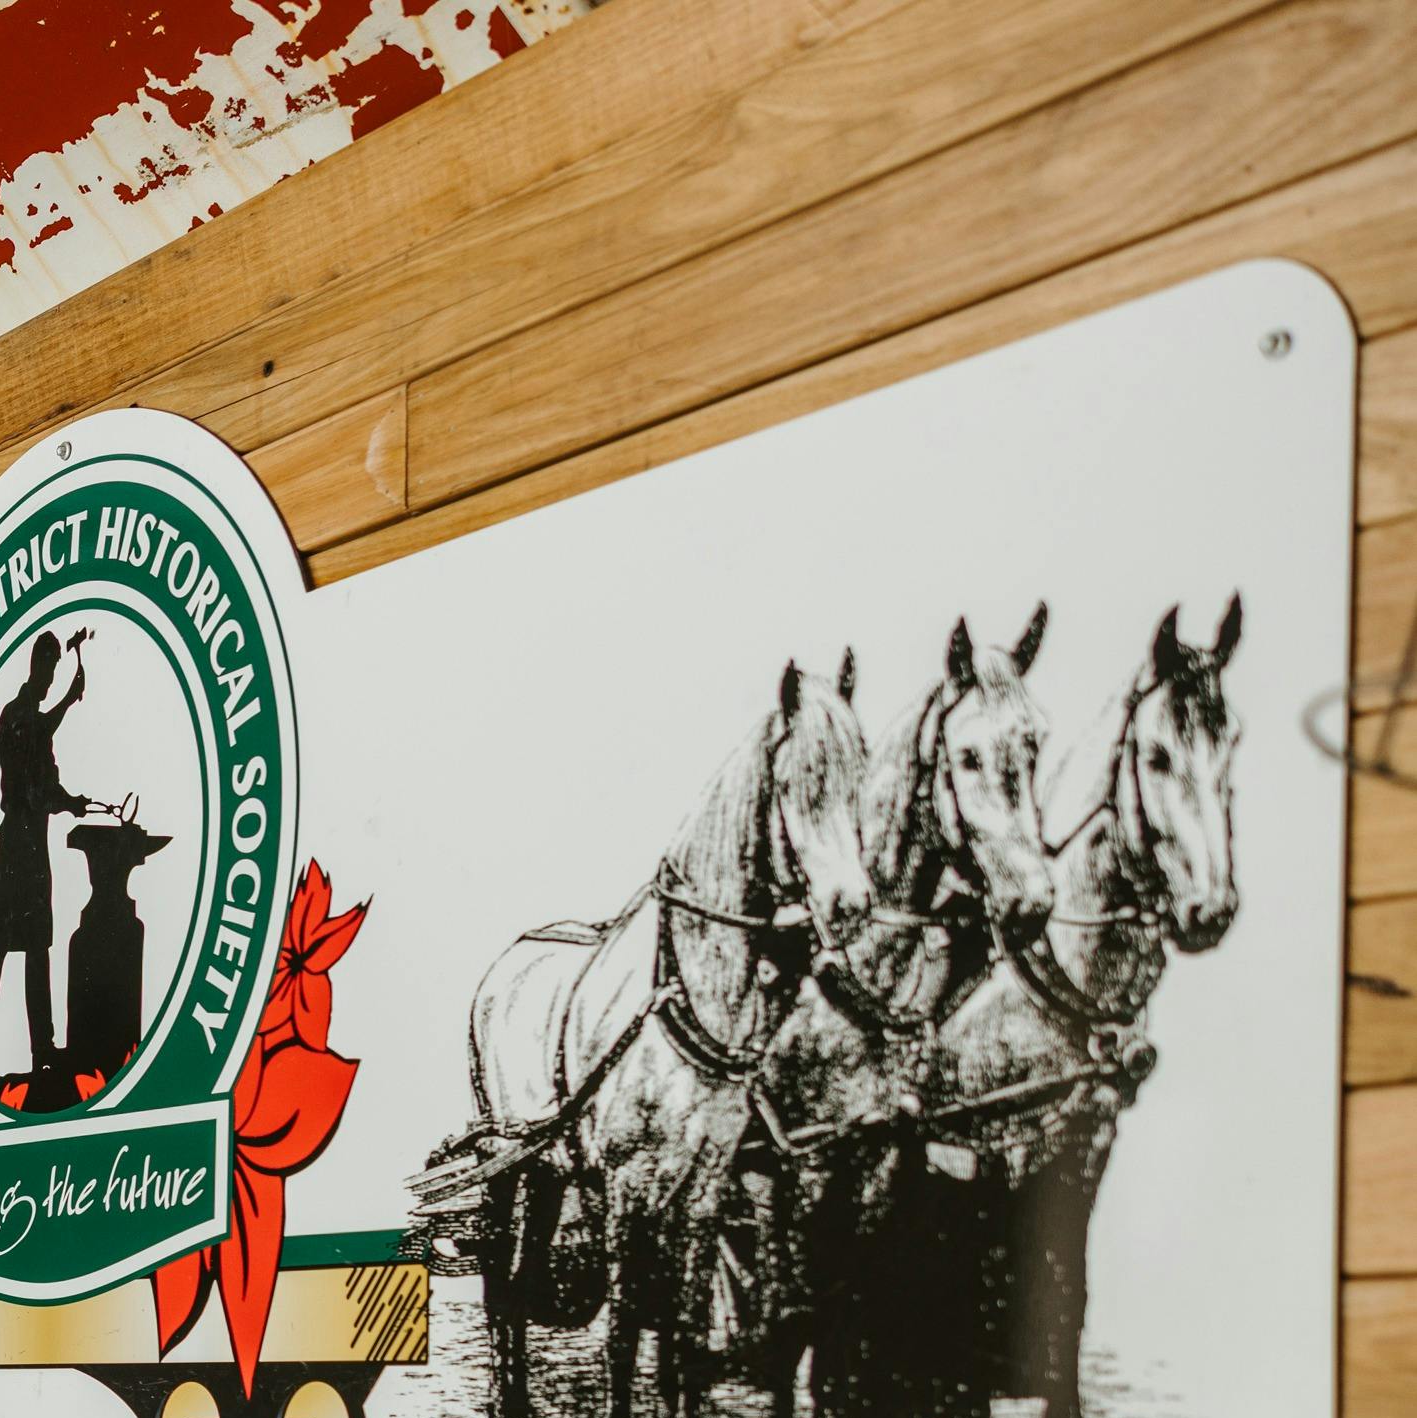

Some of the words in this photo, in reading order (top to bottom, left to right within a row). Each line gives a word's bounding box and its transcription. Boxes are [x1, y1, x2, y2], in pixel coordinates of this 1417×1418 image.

[93, 505, 264, 748] HISTORICAL
[190, 758, 269, 1054] SOCIETY
[41, 1163, 98, 1218] the
[102, 1144, 208, 1213] future
